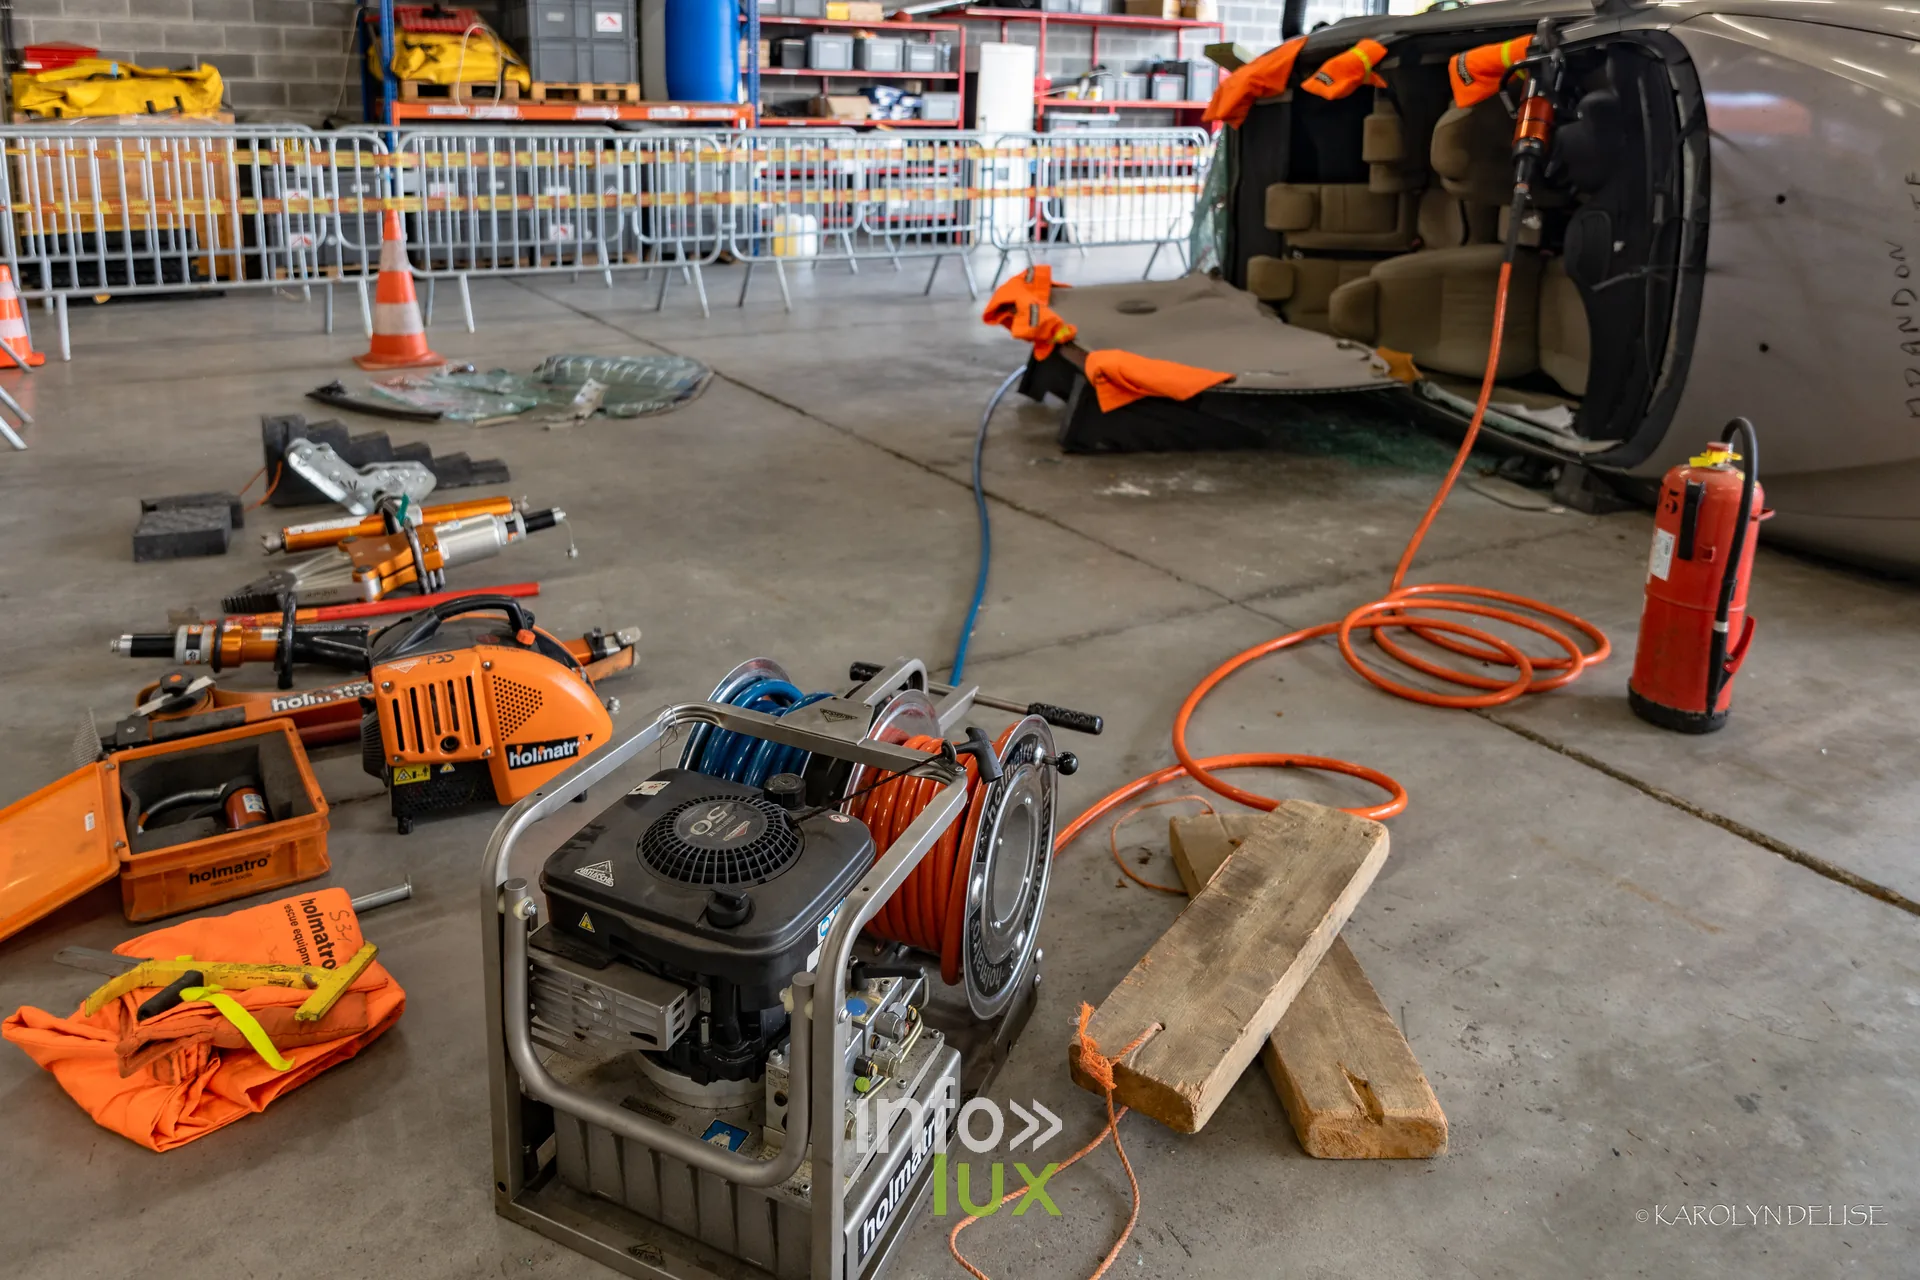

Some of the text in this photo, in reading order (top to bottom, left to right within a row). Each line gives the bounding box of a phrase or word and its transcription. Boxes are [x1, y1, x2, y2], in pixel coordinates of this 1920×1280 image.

[509, 740, 584, 768] holmatr
[189, 857, 269, 885] holmatro
[299, 897, 337, 970] holmatro
[862, 1103, 948, 1255] holmatro
